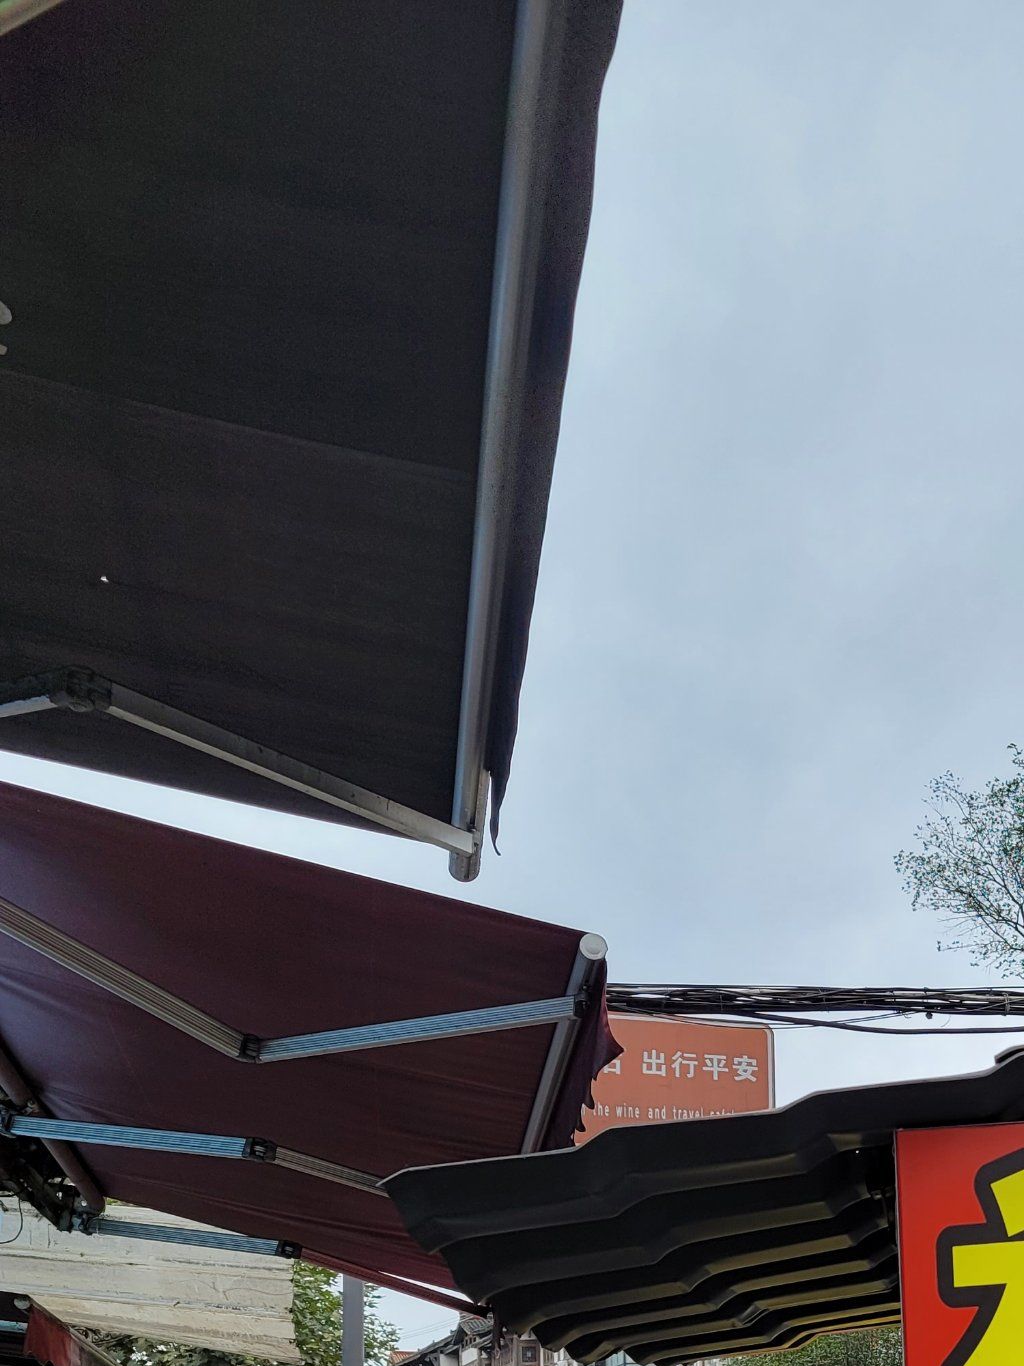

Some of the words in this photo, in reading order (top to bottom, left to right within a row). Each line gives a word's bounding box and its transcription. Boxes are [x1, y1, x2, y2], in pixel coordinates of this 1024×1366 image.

[642, 1049, 759, 1082] 出行平安
[616, 1103, 640, 1119] wine
[647, 1106, 666, 1120] and
